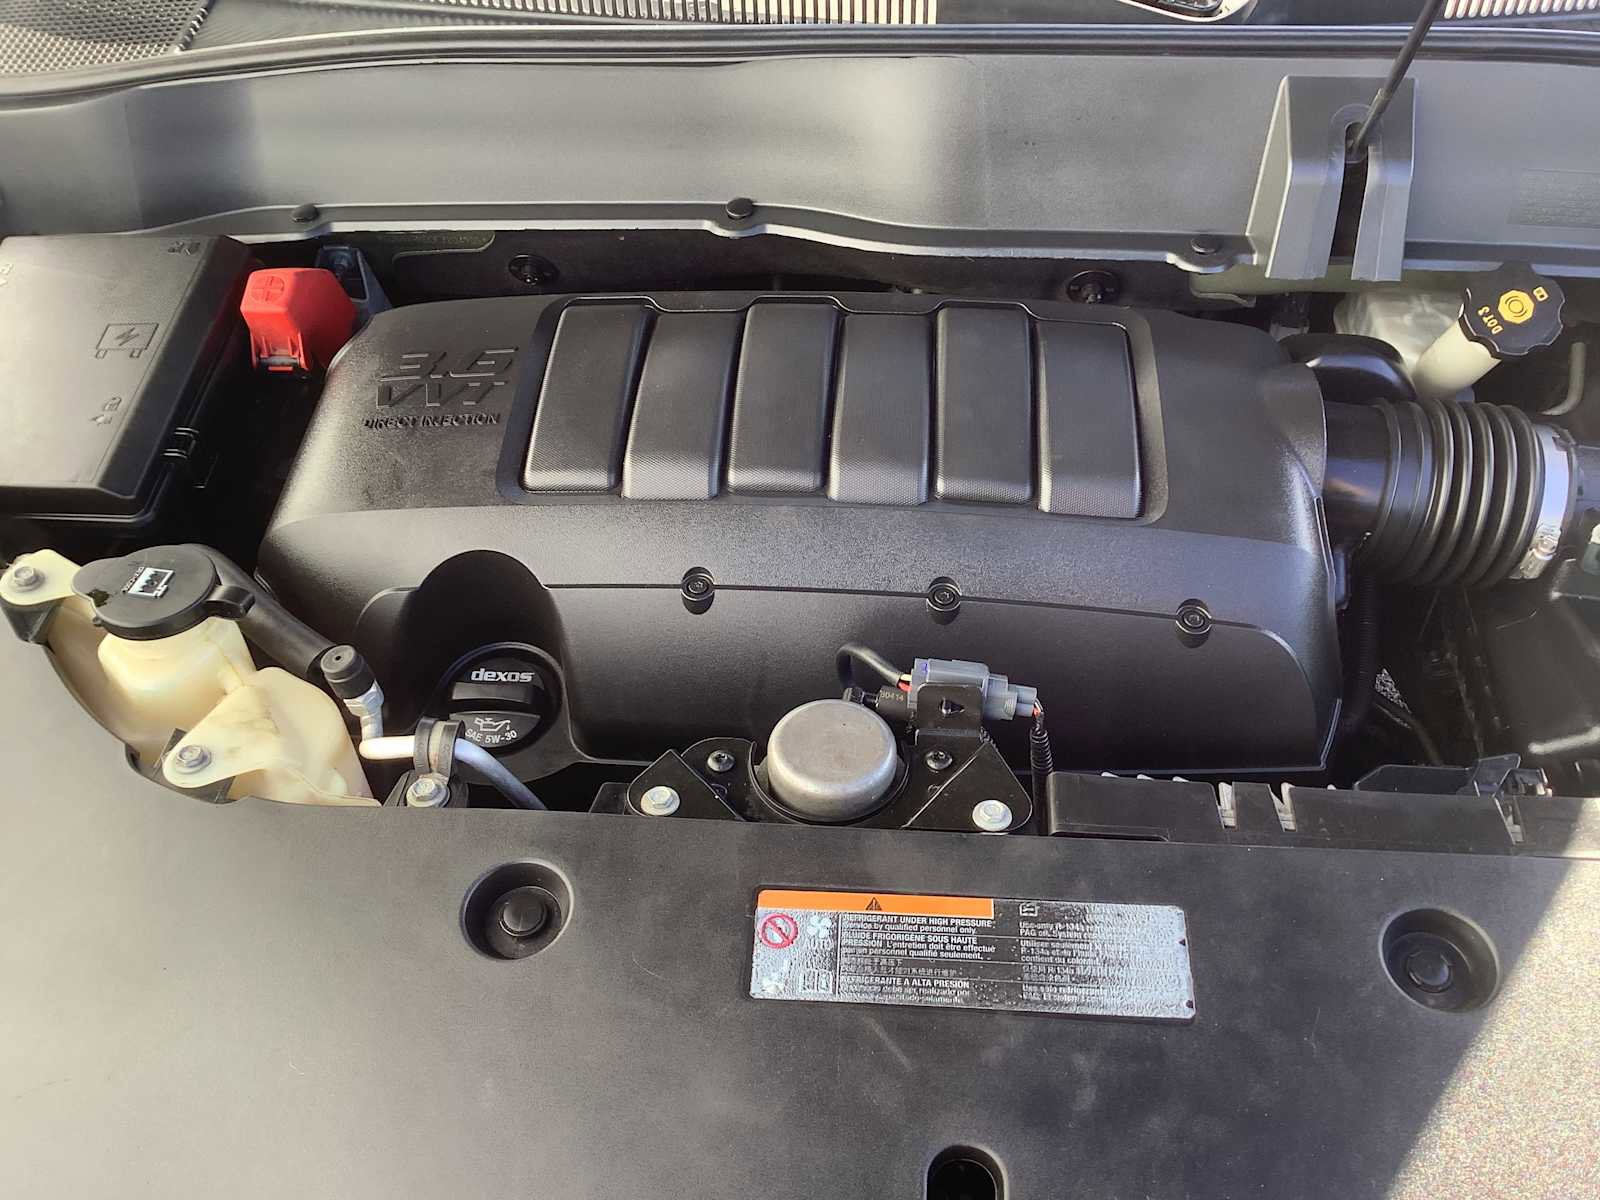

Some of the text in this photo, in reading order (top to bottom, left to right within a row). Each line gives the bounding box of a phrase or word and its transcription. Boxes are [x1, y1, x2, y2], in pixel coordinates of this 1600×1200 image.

[378, 347, 519, 382] 3.6
[375, 381, 508, 408] VVT
[363, 412, 501, 430] DIRECT INJECTION
[471, 668, 535, 682] dexos
[465, 728, 517, 744] SAE 5W-30
[843, 914, 898, 924] REFRIGERANT
[900, 917, 927, 925] UNDER
[928, 918, 949, 926] HIGH
[874, 923, 882, 931] by
[884, 923, 918, 932] qualified
[919, 925, 958, 934] personnel
[1020, 928, 1037, 937] PAG
[842, 931, 871, 940] FLUIDE
[950, 937, 978, 945] HAUTE
[1020, 939, 1050, 948] Utiliser
[886, 941, 927, 950] L'entretien
[928, 942, 944, 950] doit
[945, 943, 961, 951] être
[962, 944, 996, 953] effectué
[868, 948, 908, 957] personnel
[909, 950, 938, 959] qualifié
[1020, 955, 1053, 963] contient
[841, 975, 901, 986] REFRIGERANTE
[911, 978, 933, 986] ALTA
